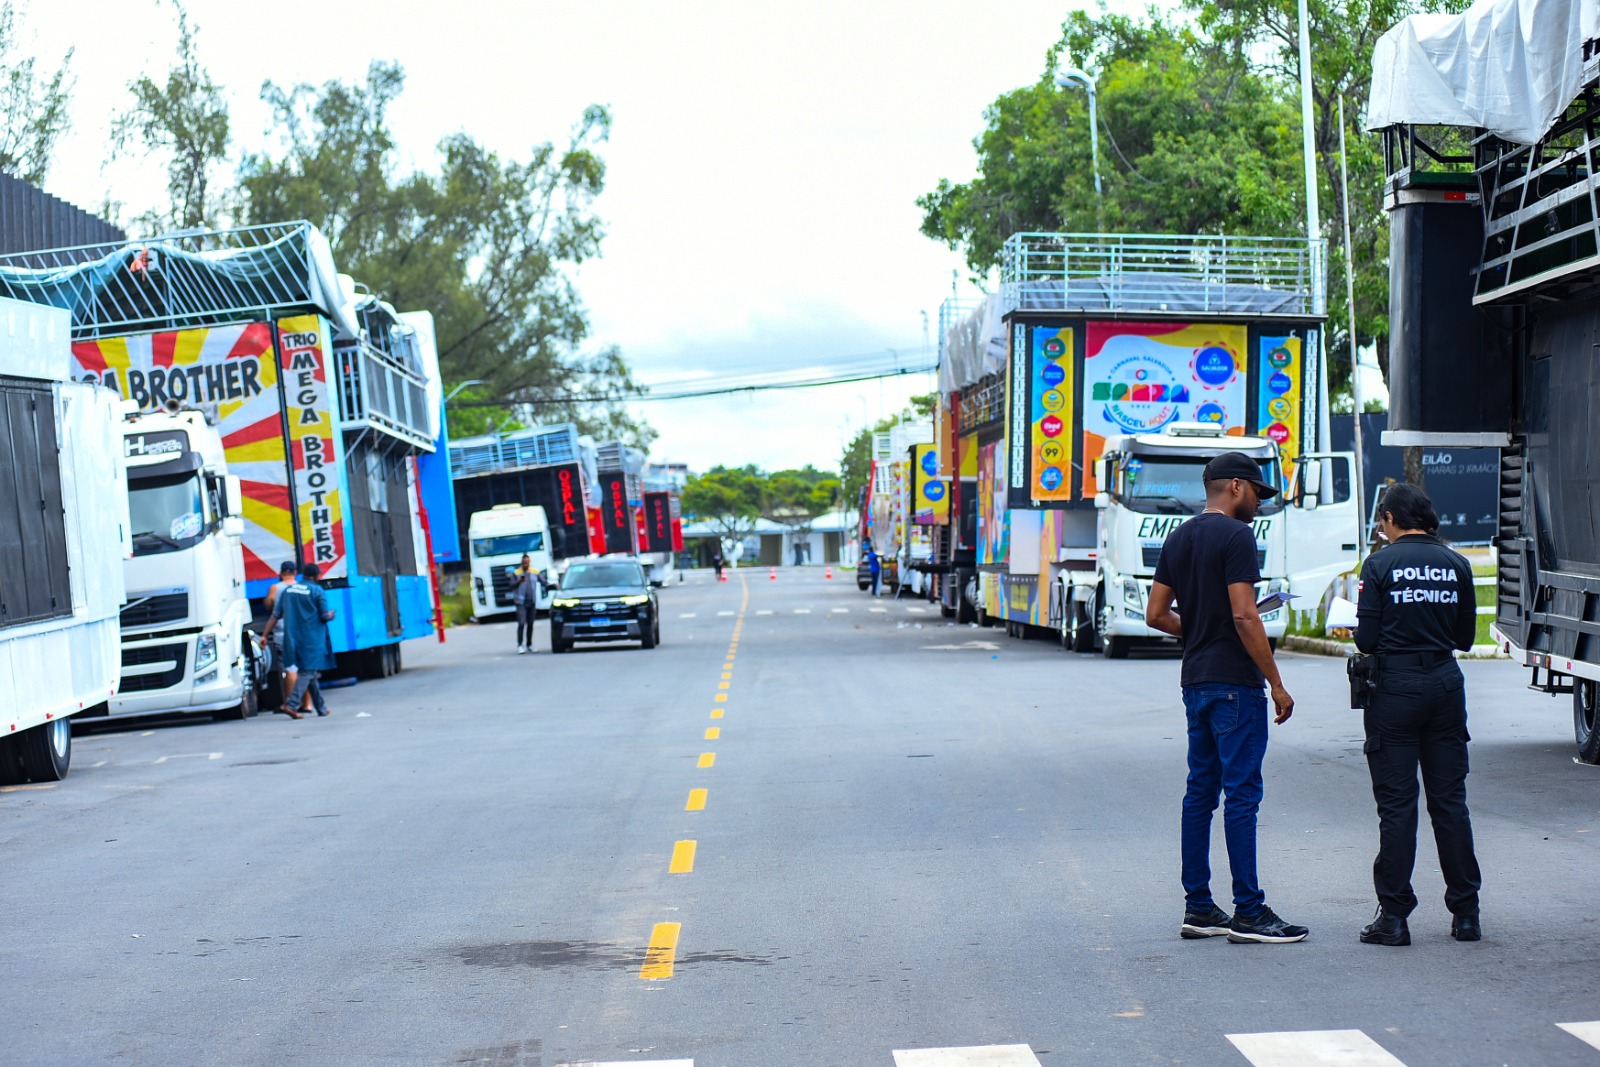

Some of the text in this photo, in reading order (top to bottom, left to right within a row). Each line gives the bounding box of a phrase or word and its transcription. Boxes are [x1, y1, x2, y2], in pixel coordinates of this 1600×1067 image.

[283, 332, 317, 348] TRIO
[129, 359, 262, 409] BROTHER
[292, 353, 320, 425] MEGA
[1112, 404, 1146, 428] NASCEU
[1045, 448, 1059, 458] 99
[1421, 453, 1452, 465] EILÃO
[1427, 464, 1457, 475] HARAS
[1458, 465, 1465, 475] 2
[303, 436, 334, 562] BROTHER
[1392, 566, 1457, 582] POLÍCIA
[1390, 587, 1458, 603] TÉCNICA
